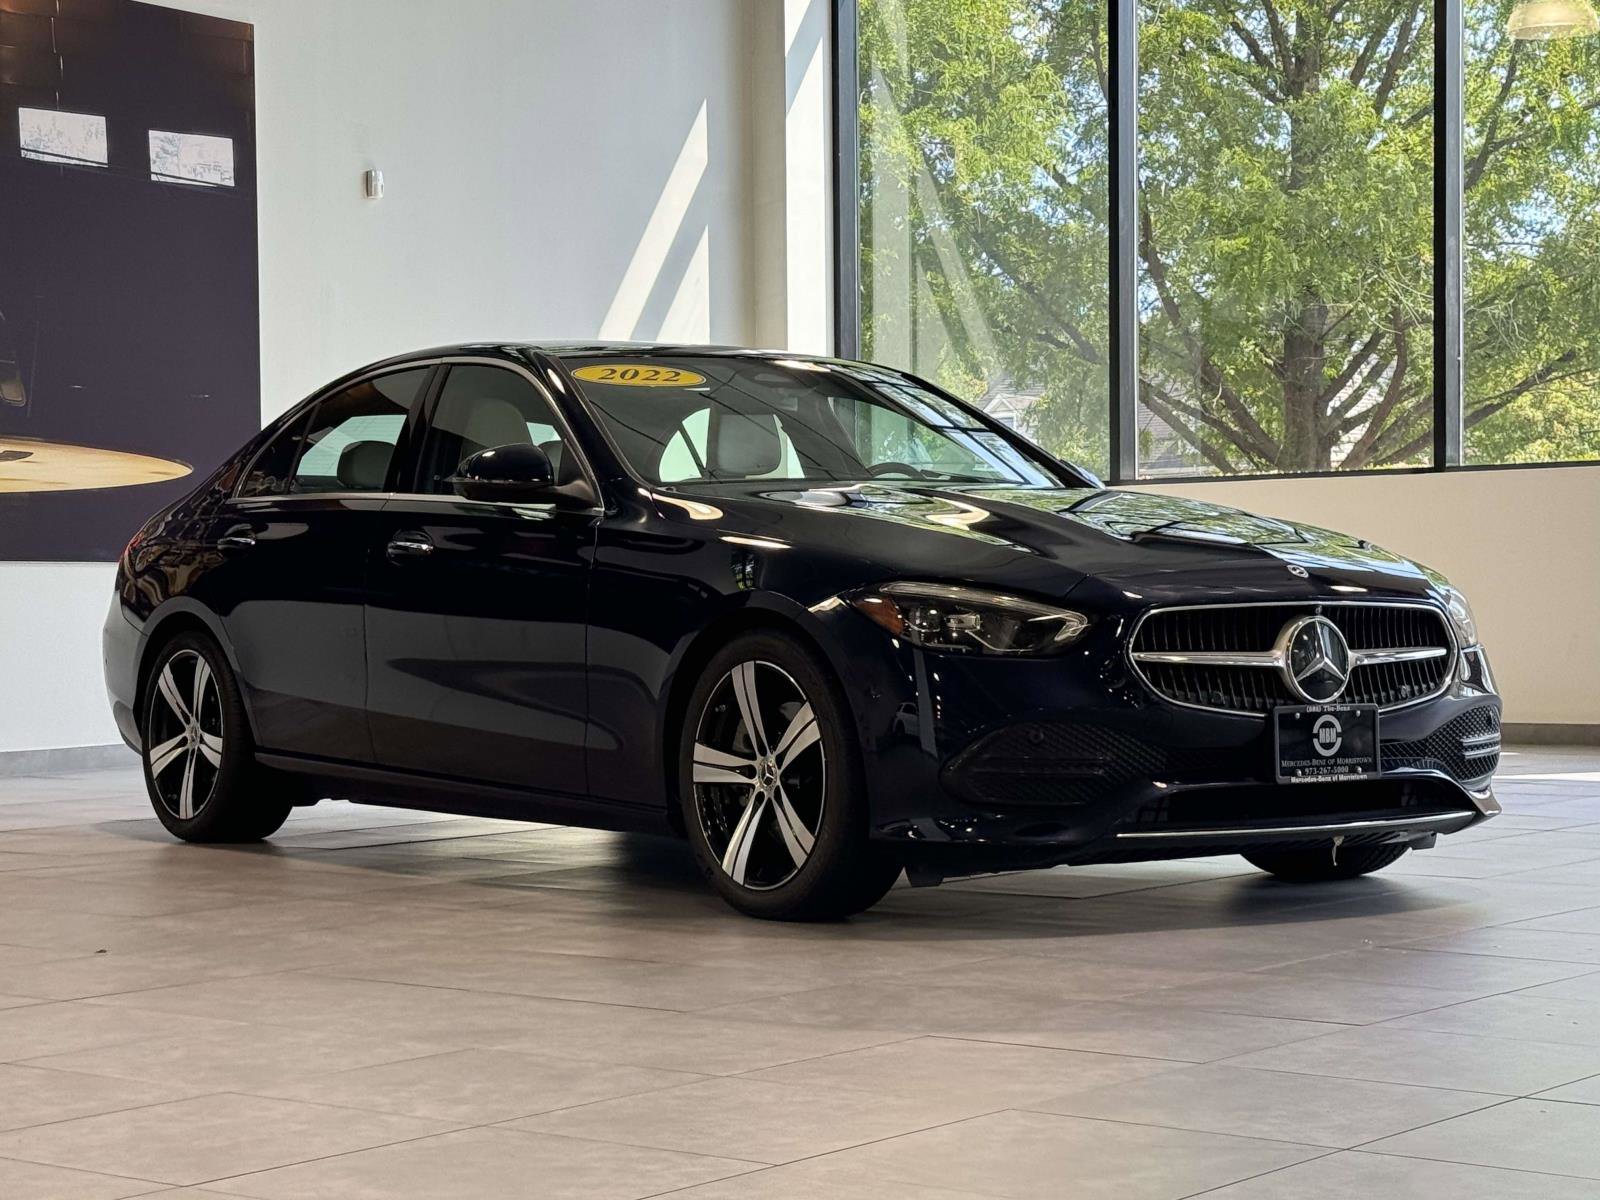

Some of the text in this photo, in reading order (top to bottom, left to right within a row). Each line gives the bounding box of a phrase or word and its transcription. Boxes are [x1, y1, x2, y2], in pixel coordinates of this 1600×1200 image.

[598, 368, 681, 382] 2022
[1319, 728, 1336, 743] MBM
[1304, 765, 1349, 776] 973-267-5000
